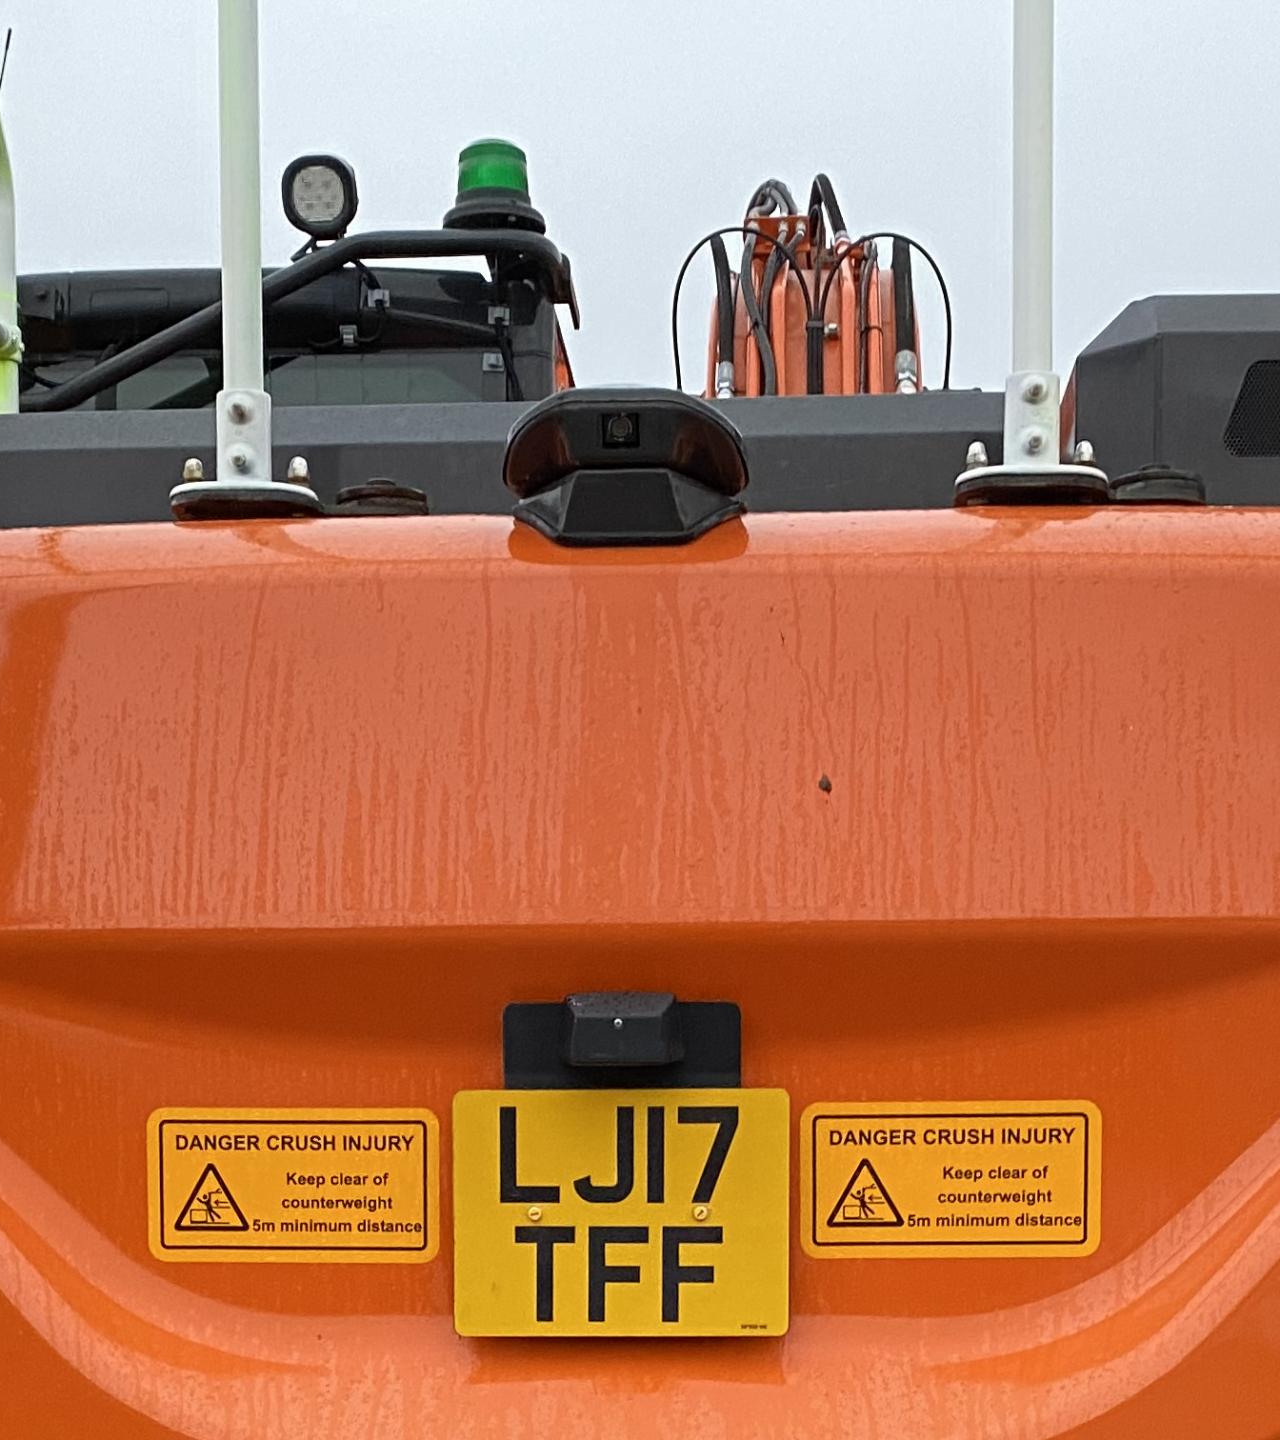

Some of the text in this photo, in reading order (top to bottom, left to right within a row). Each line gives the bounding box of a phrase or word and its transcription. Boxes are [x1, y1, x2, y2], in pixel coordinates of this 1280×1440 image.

[176, 1135, 414, 1151] DANGER CRUSH INJURY
[829, 1127, 1076, 1146] DANGER CRUSH INJURY
[499, 1105, 740, 1205] LJ17
[286, 1172, 389, 1188] Keep clear of
[943, 1166, 1048, 1182] Keep clear of
[281, 1197, 393, 1212] counterweight
[937, 1190, 1052, 1205] counterweight
[253, 1220, 422, 1233] 5m minimum distance
[907, 1213, 1082, 1227] 5m minimum distance
[514, 1225, 724, 1323] TFF
